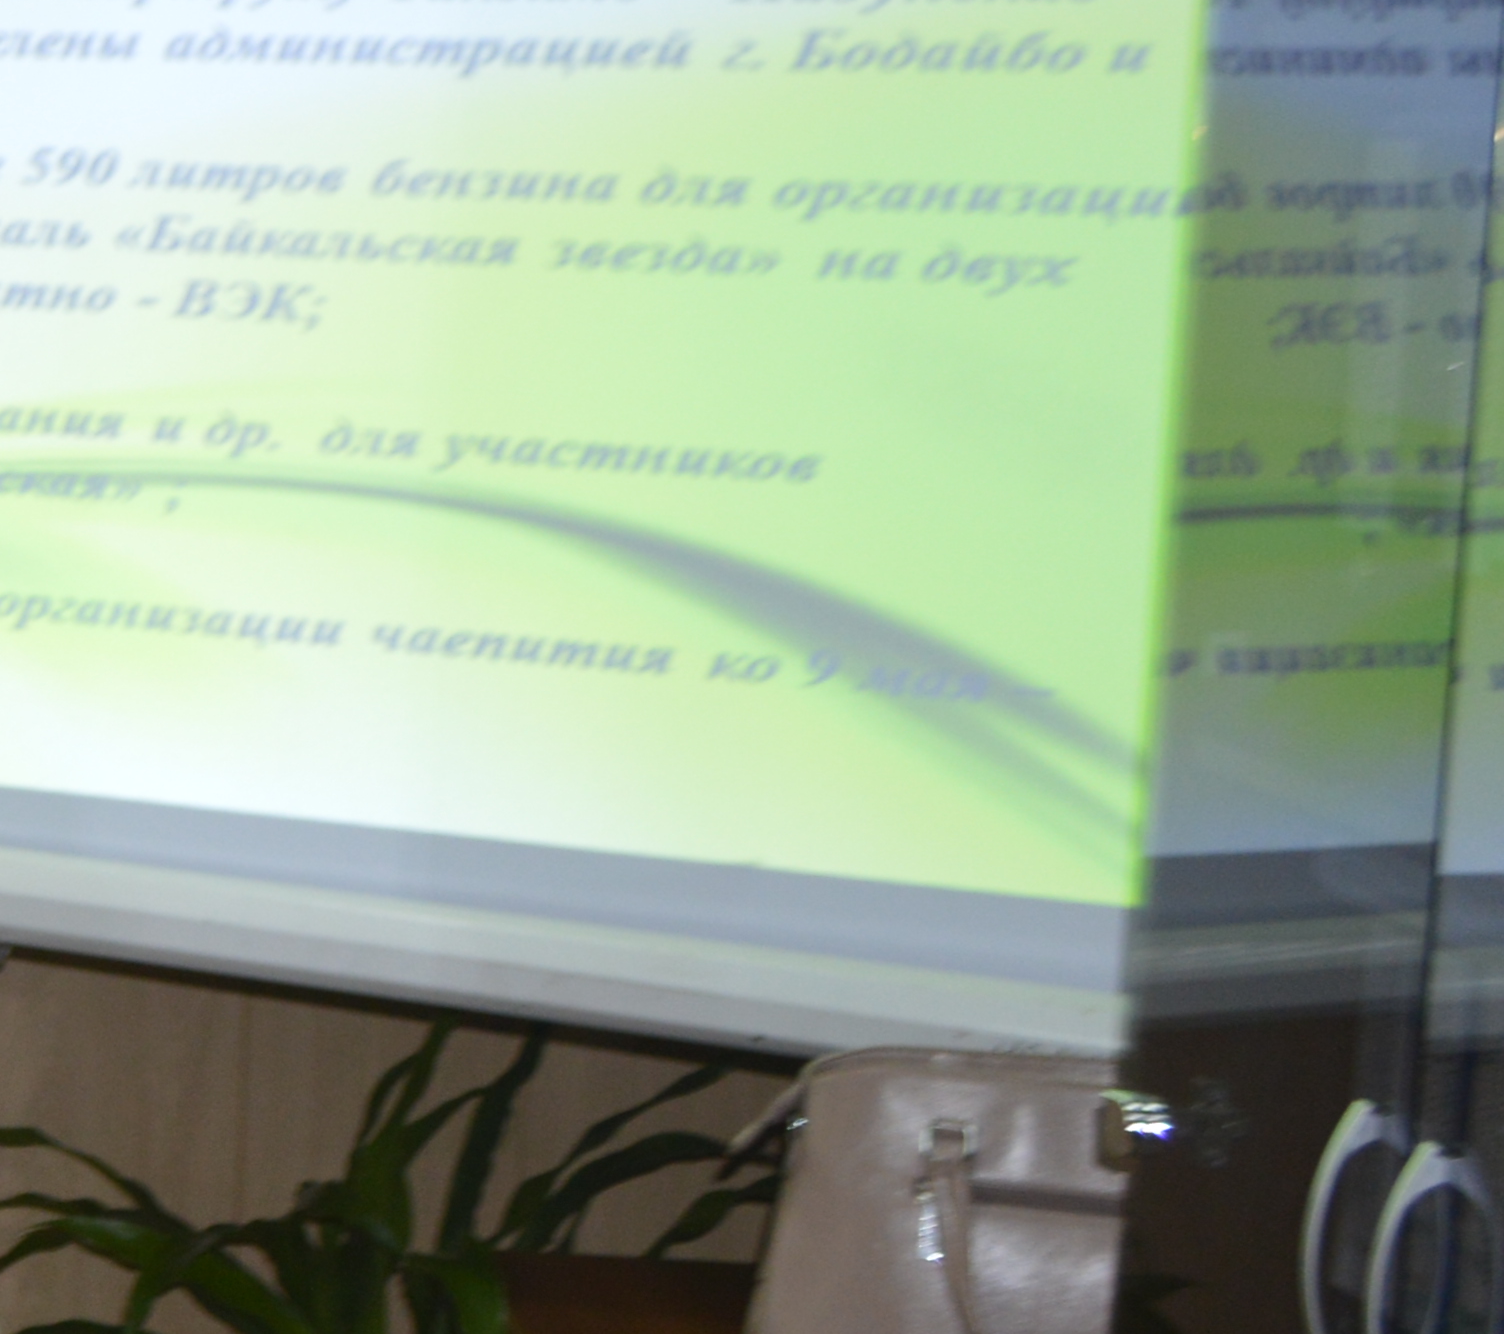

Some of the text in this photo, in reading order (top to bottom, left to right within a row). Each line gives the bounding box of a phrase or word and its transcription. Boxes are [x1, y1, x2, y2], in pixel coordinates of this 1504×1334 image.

[18, 144, 120, 187] 590
[131, 158, 349, 203] литров
[369, 157, 621, 204] бензина
[637, 162, 755, 211] для
[113, 211, 521, 267] «Байкальская
[549, 232, 781, 276] звезда»
[814, 244, 902, 283] на
[918, 241, 1080, 299] двух
[170, 275, 328, 332] ВЭК;
[150, 413, 187, 444] и
[204, 408, 283, 458] др.
[318, 417, 419, 460] для
[434, 427, 827, 485] участников
[368, 620, 678, 676] чаепития
[704, 650, 783, 686] ко
[799, 647, 841, 689] 9
